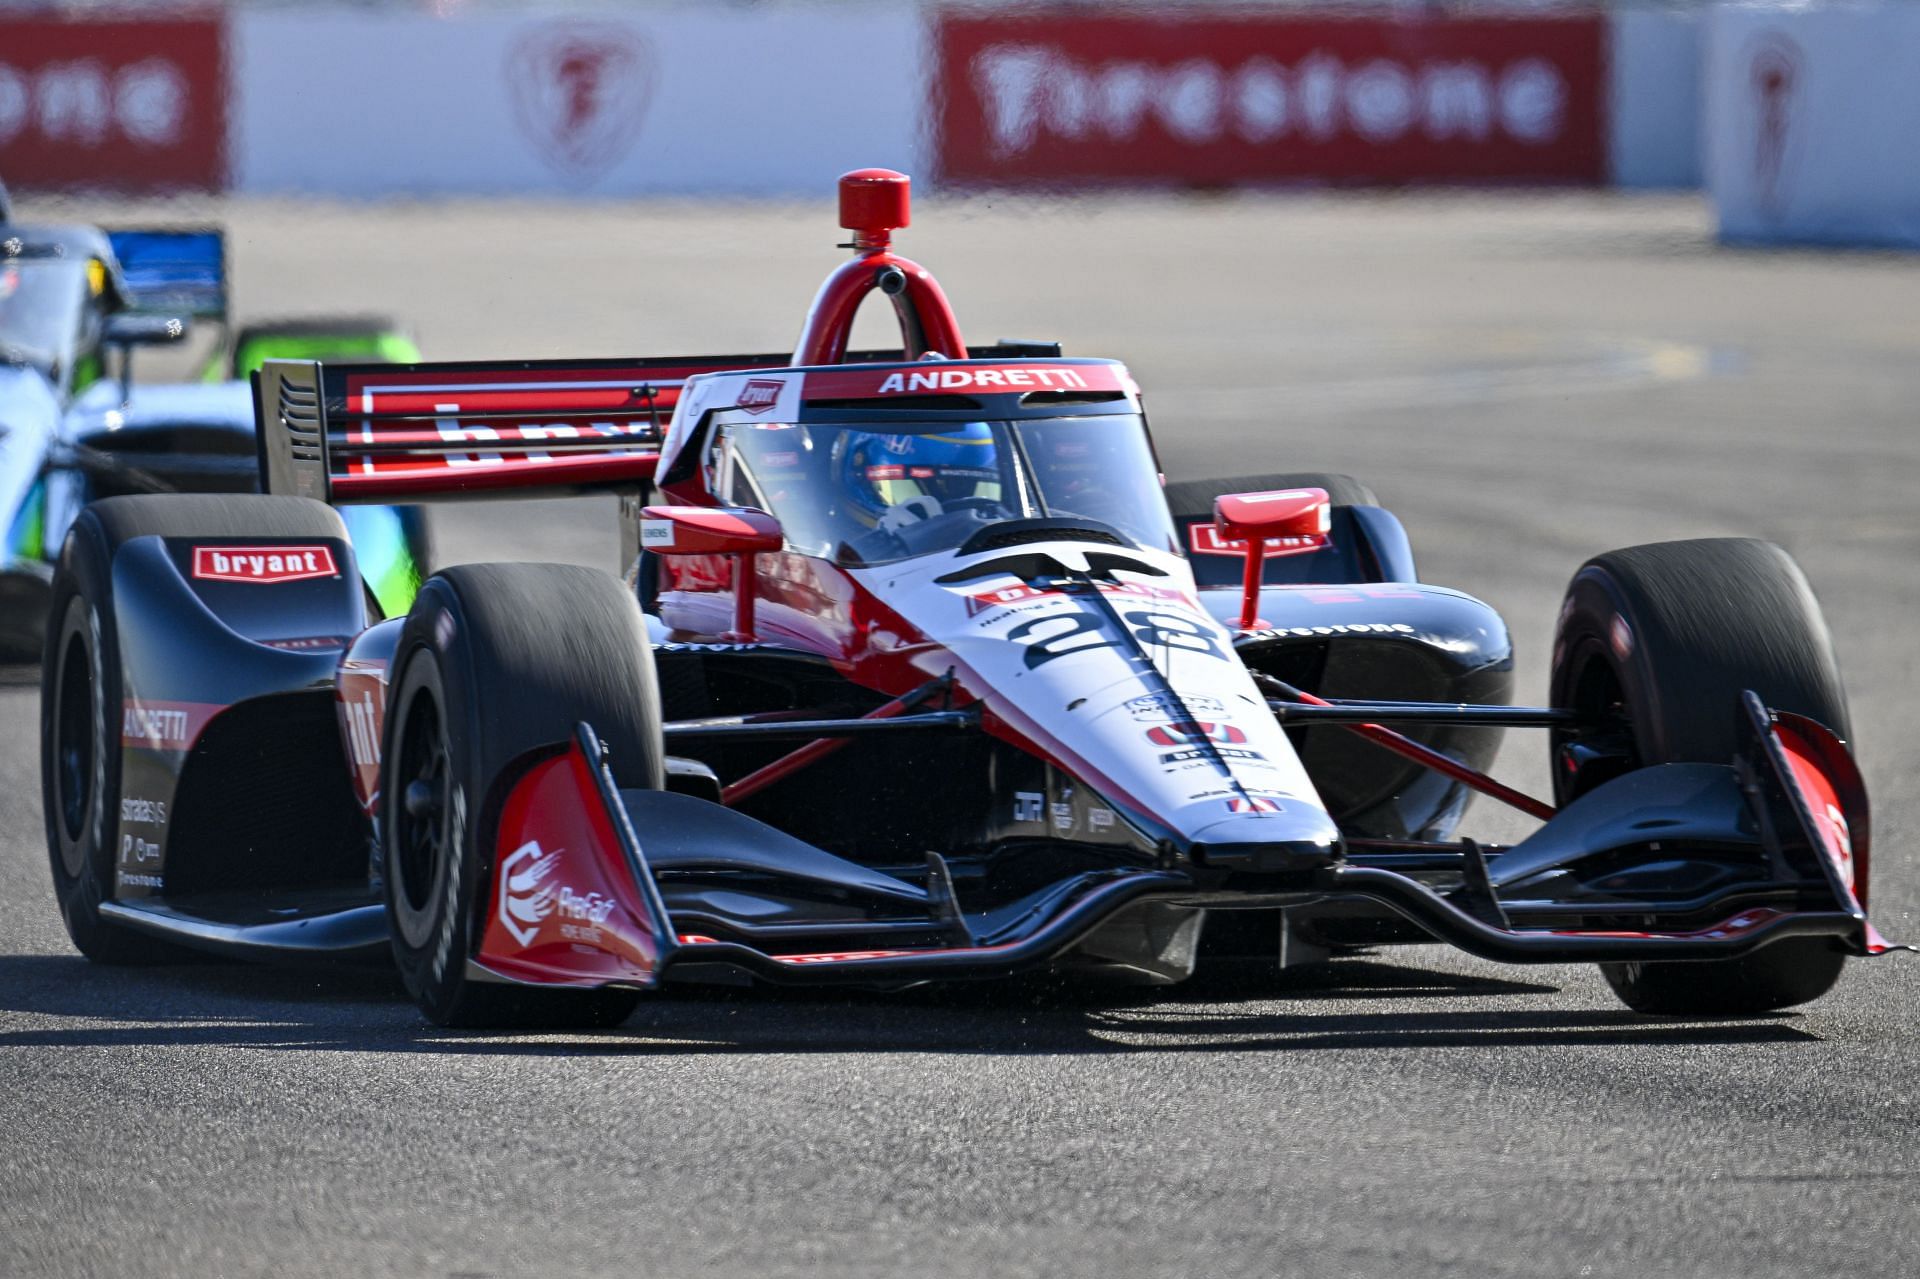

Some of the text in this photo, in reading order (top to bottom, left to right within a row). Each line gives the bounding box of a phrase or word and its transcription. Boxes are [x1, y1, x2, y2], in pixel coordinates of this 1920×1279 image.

[878, 369, 1087, 393] ANDRETTI
[212, 550, 318, 576] bryant
[123, 708, 188, 741] ANDRETTI
